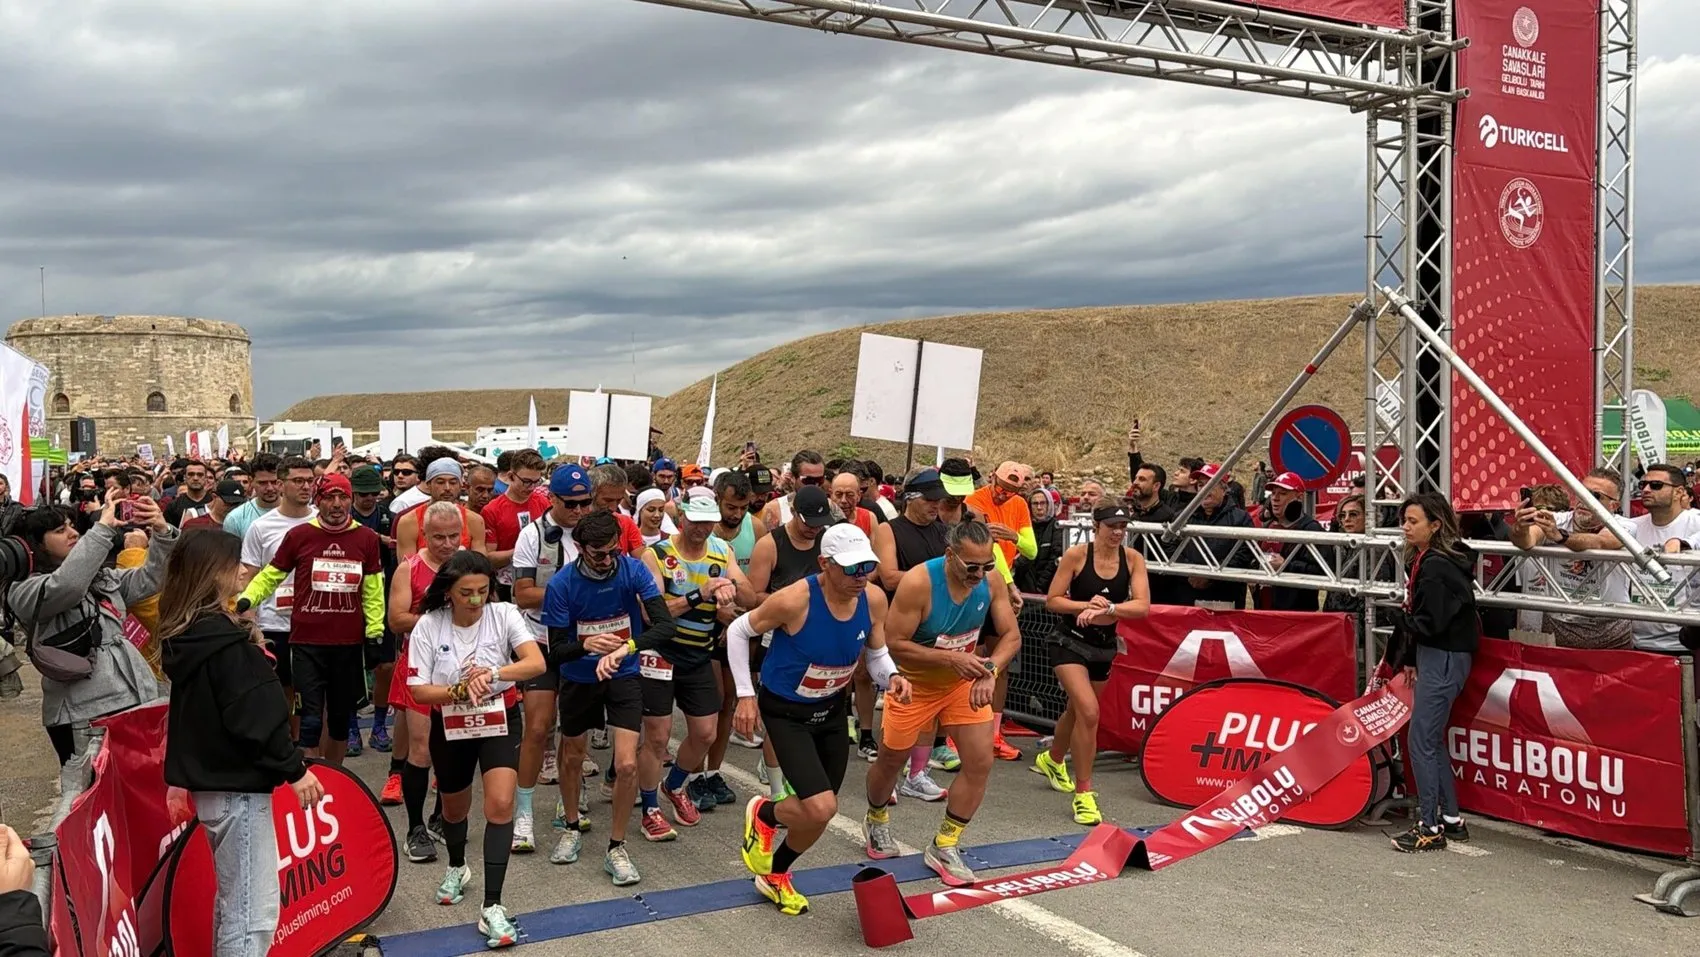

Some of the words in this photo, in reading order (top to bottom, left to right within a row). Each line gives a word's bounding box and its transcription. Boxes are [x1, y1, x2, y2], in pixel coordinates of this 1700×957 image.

[1500, 125, 1569, 153] TURKCELL
[328, 572, 346, 583] 53
[641, 656, 658, 668] 13
[826, 679, 836, 688] 9
[463, 714, 486, 728] 55
[1218, 711, 1318, 752] PLU
[1450, 764, 1626, 817] MARATONU
[271, 885, 353, 946] .plustiming.com
